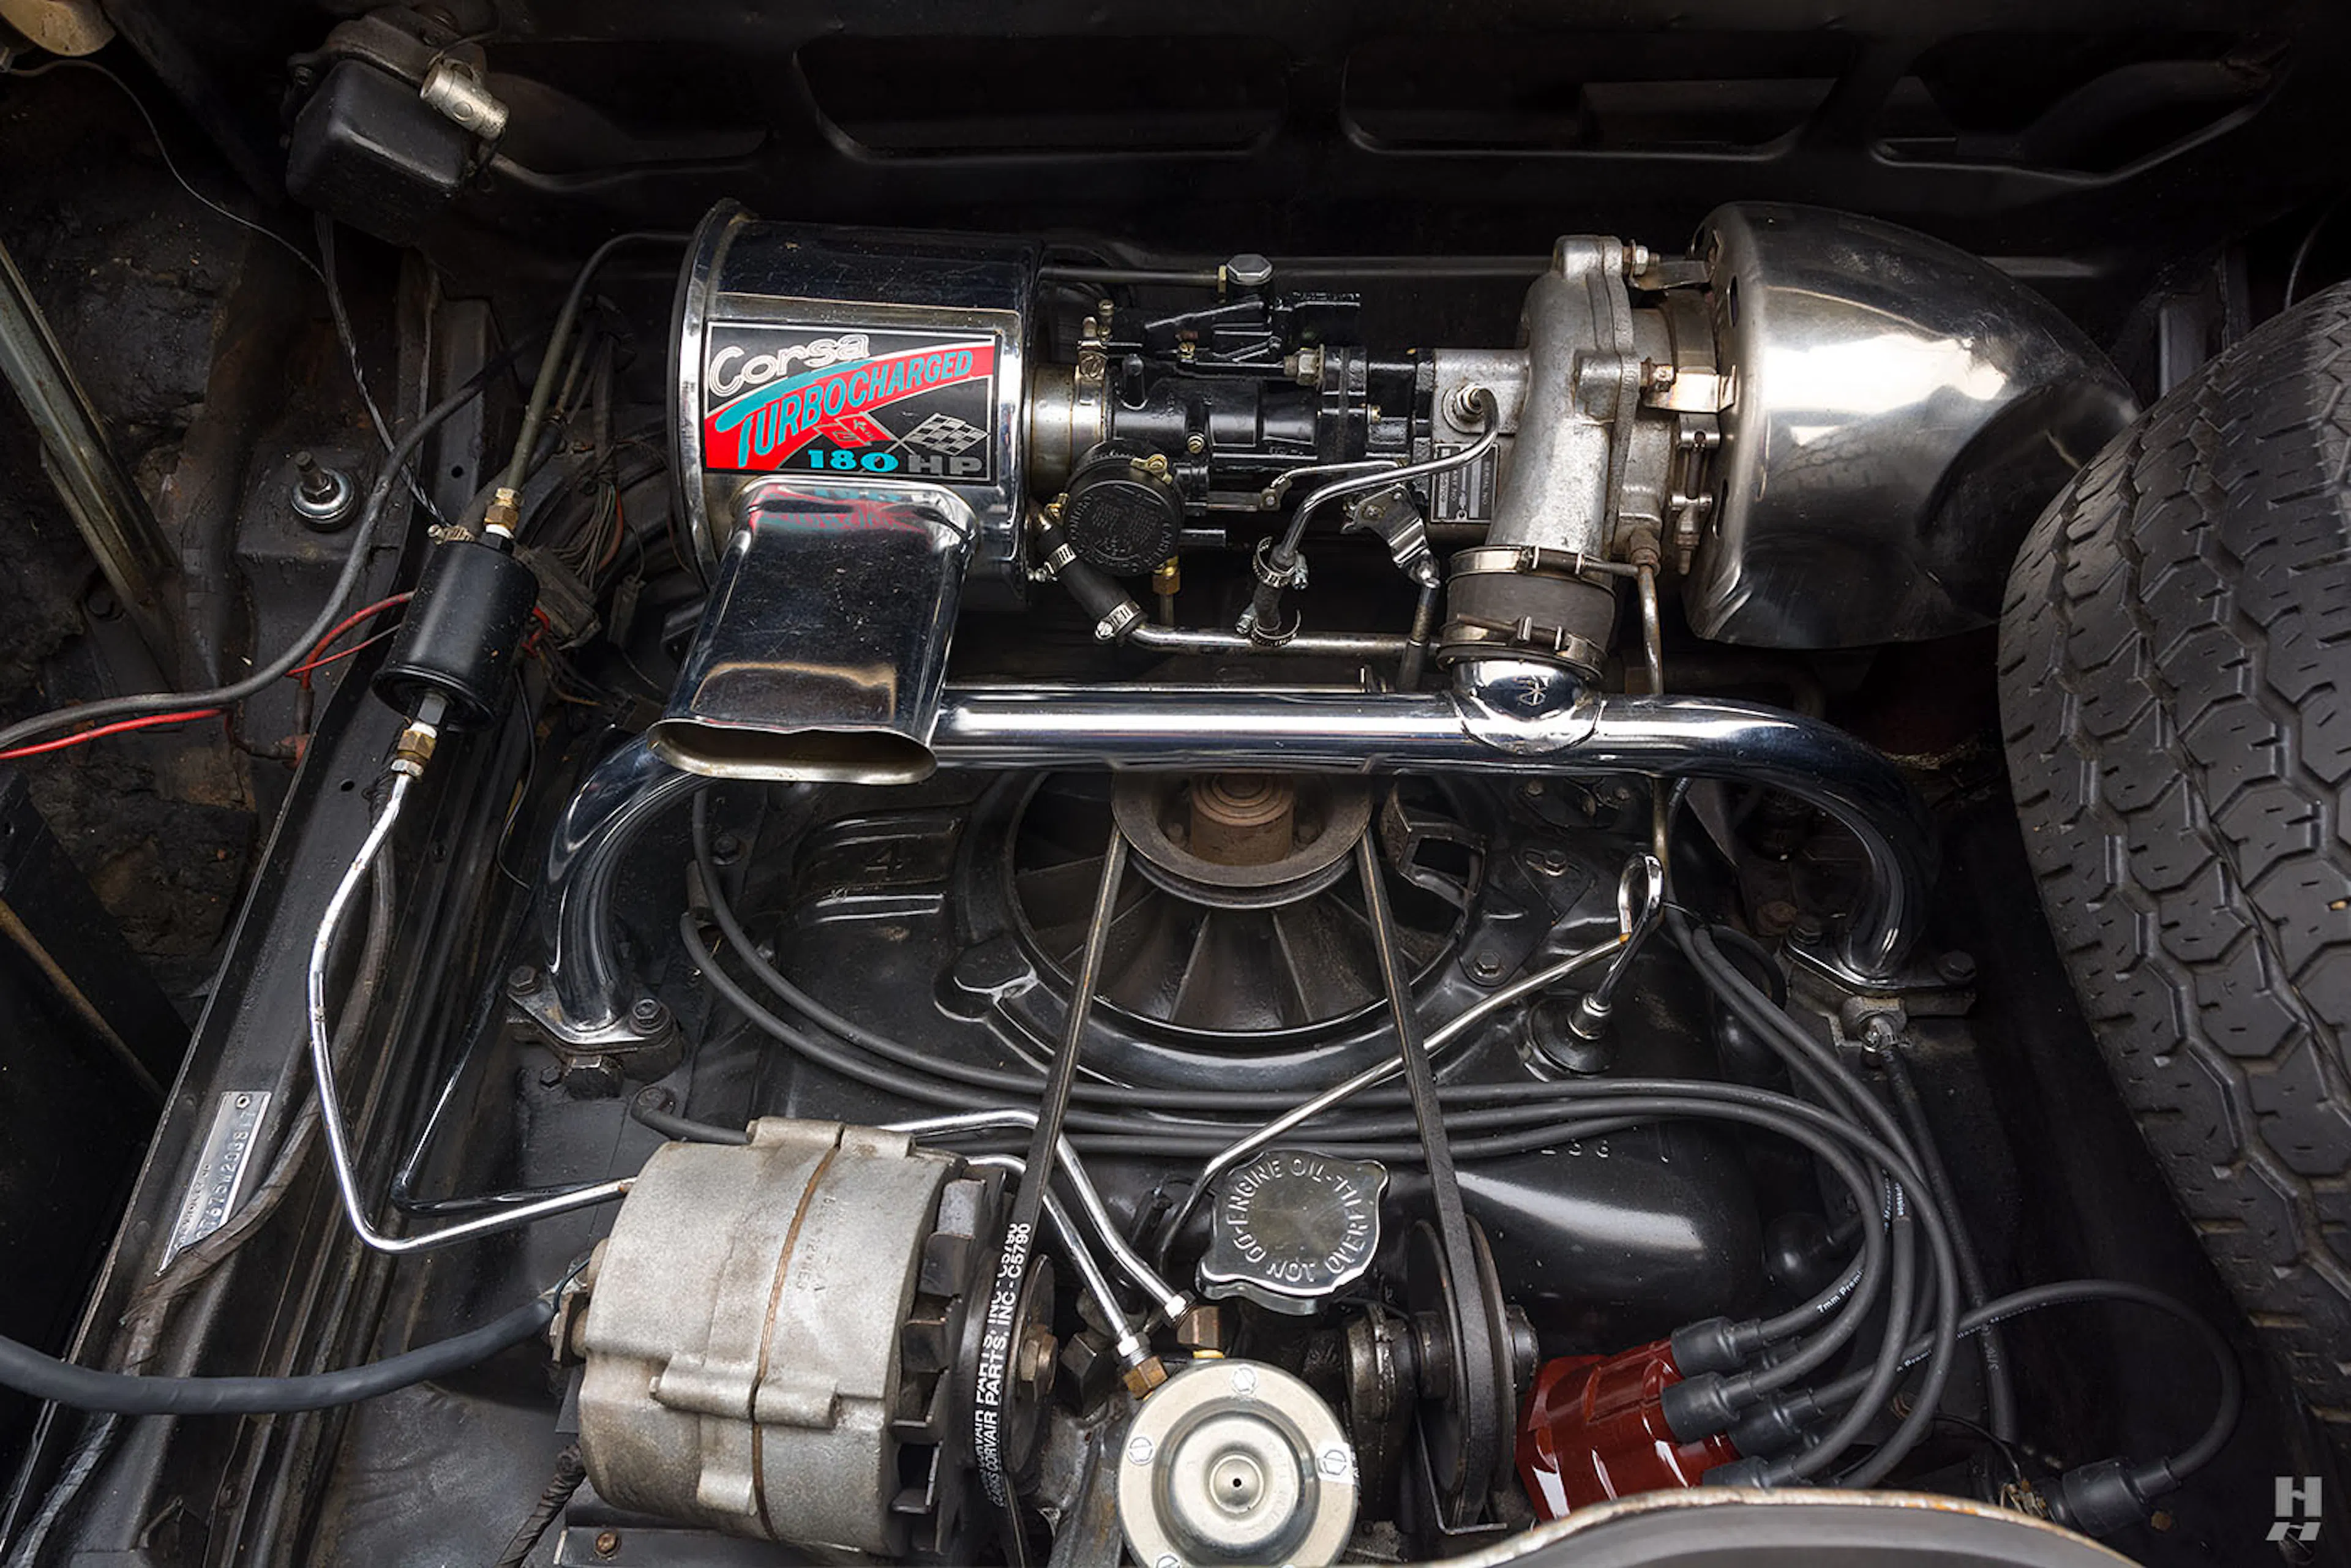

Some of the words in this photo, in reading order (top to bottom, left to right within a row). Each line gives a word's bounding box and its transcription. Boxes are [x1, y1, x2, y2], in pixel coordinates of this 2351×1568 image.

[708, 334, 871, 397] Corsa
[716, 350, 973, 468] TURBOCHARGED
[807, 448, 899, 473] 180
[907, 454, 984, 476] HP
[1226, 1160, 1283, 1225] ENGINE
[1290, 1158, 1324, 1182] OIL
[1007, 1223, 1032, 1278] C5790
[1232, 1233, 1266, 1263] DO
[1000, 1290, 1017, 1326] INC
[1816, 1294, 1840, 1313] 7mm
[981, 1411, 999, 1474] CORVAIR
